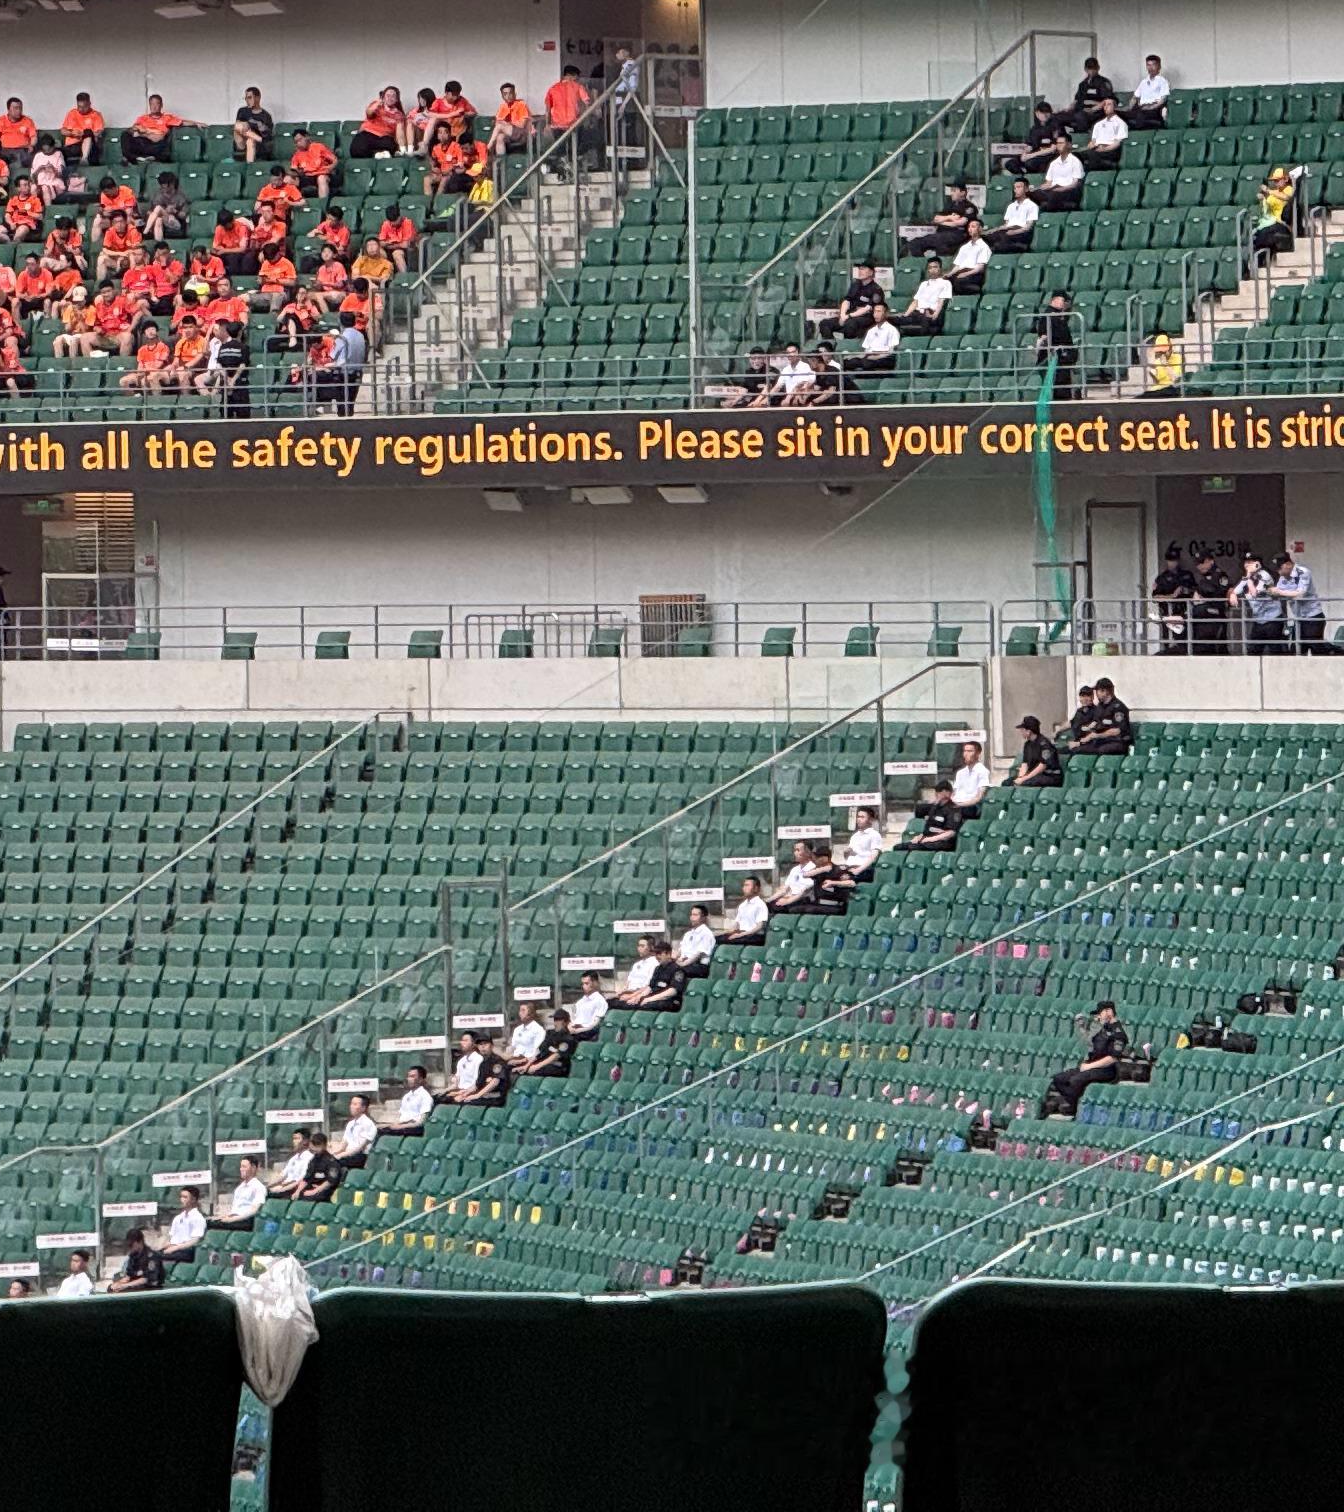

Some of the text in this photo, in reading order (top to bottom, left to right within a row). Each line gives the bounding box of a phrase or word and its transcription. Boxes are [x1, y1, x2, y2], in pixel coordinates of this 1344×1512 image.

[81, 430, 130, 470] all
[144, 430, 217, 469] the
[232, 425, 361, 478] safety
[375, 422, 623, 477] regulations.
[639, 420, 764, 460] Please
[777, 417, 823, 457] sit
[835, 415, 870, 457] in
[882, 421, 969, 468] your
[980, 413, 1109, 454] correct
[1120, 412, 1198, 452] seat.
[1212, 409, 1237, 449] It
[1246, 408, 1270, 448] is
